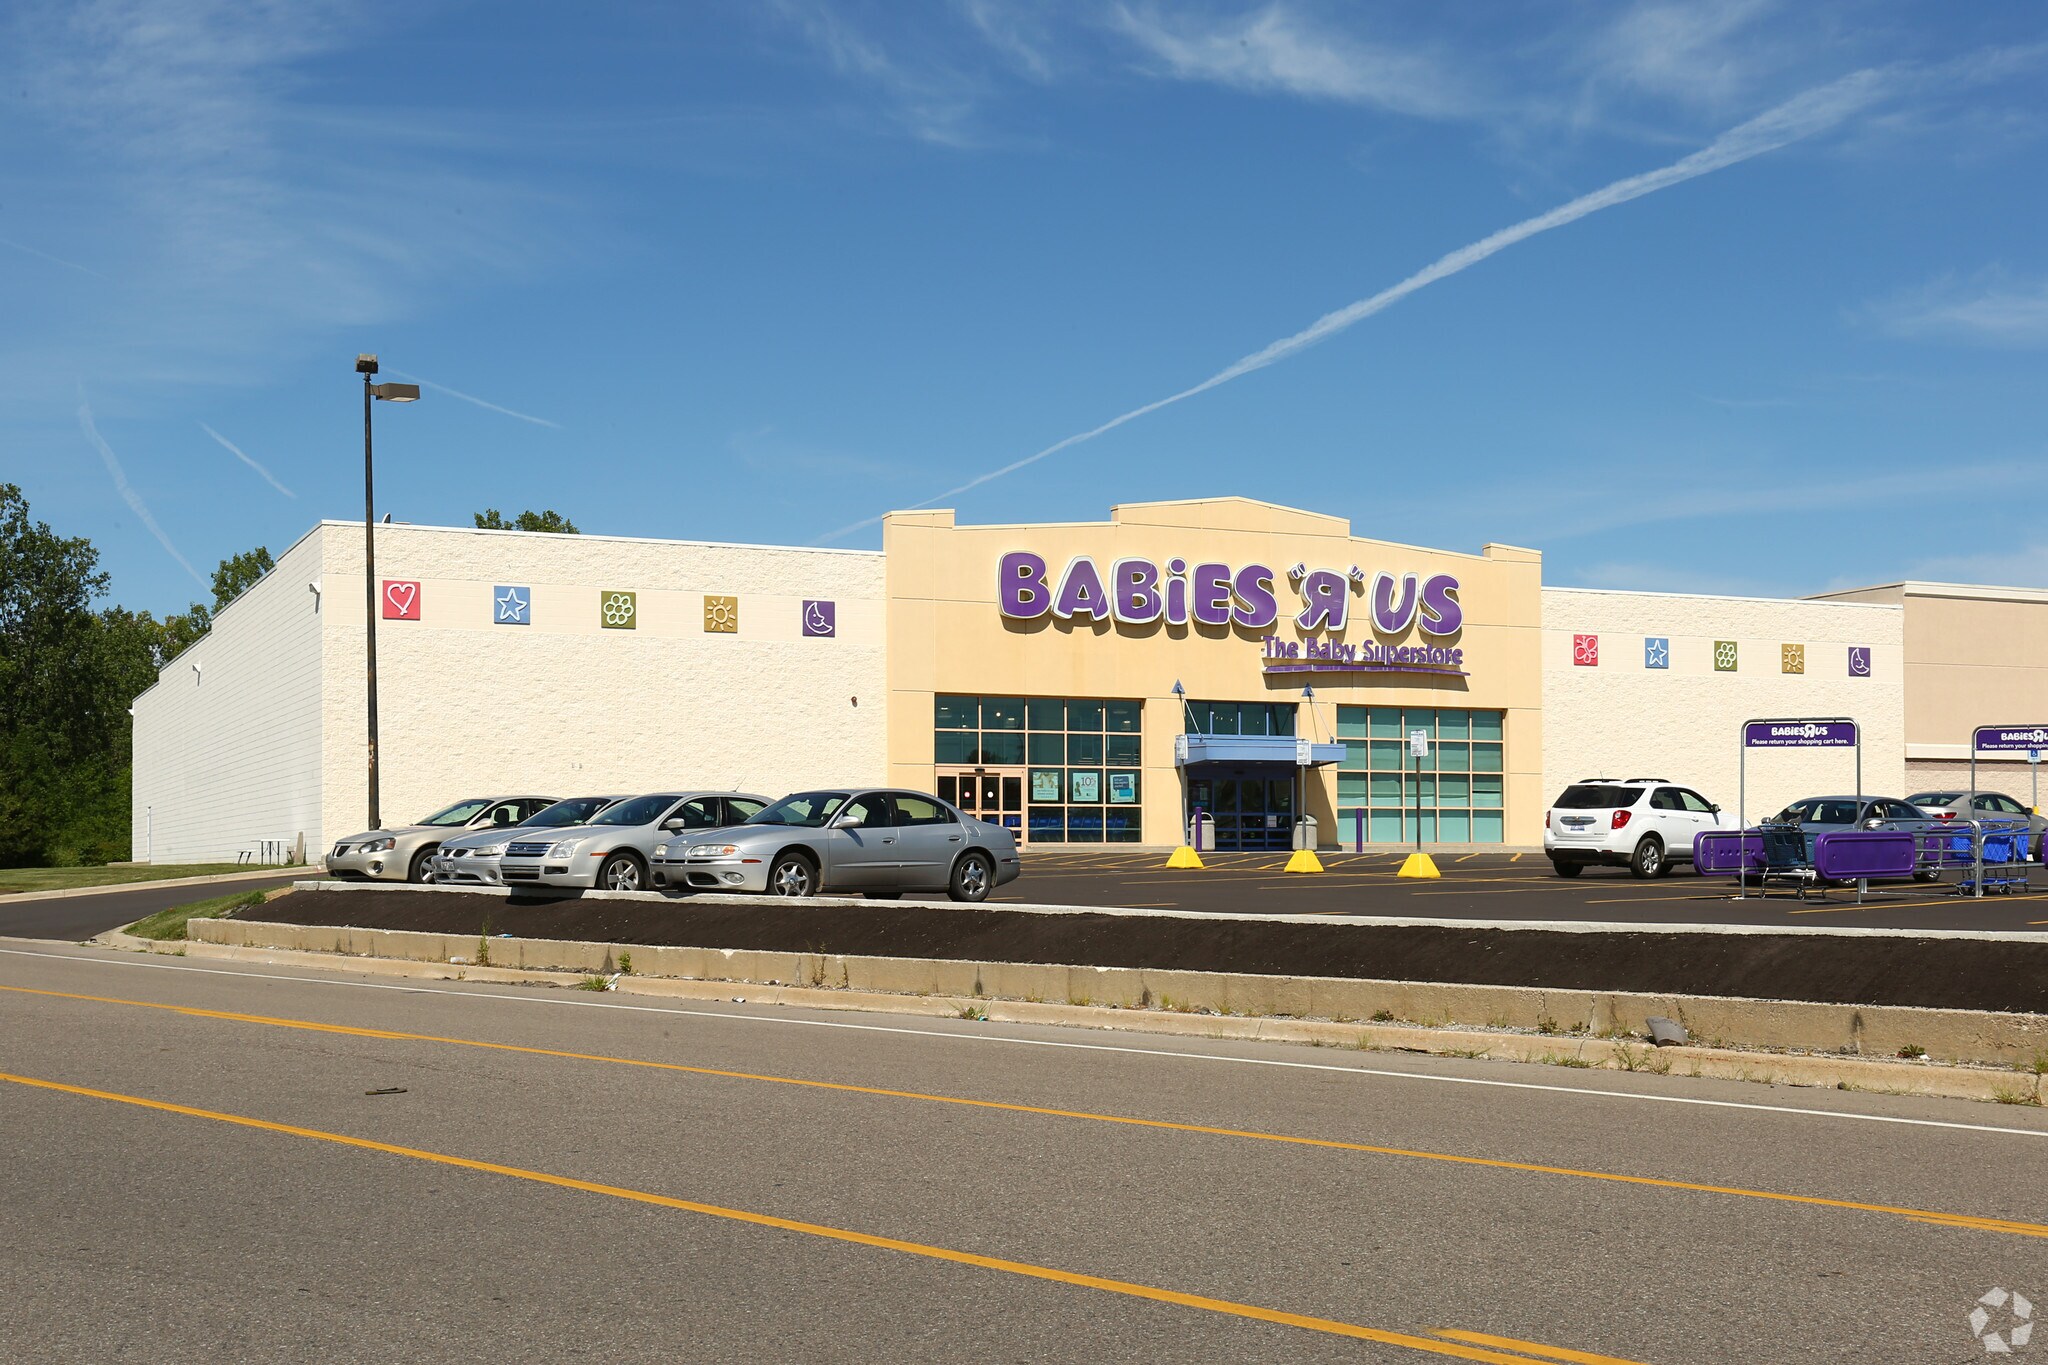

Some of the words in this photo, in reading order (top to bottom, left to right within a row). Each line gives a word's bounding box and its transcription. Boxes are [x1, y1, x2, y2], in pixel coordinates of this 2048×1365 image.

[1370, 571, 1463, 636] US
[1262, 635, 1299, 659] The
[1305, 636, 1357, 664] Baby
[1362, 639, 1464, 666] Superstore
[1797, 738, 1822, 746] shopping
